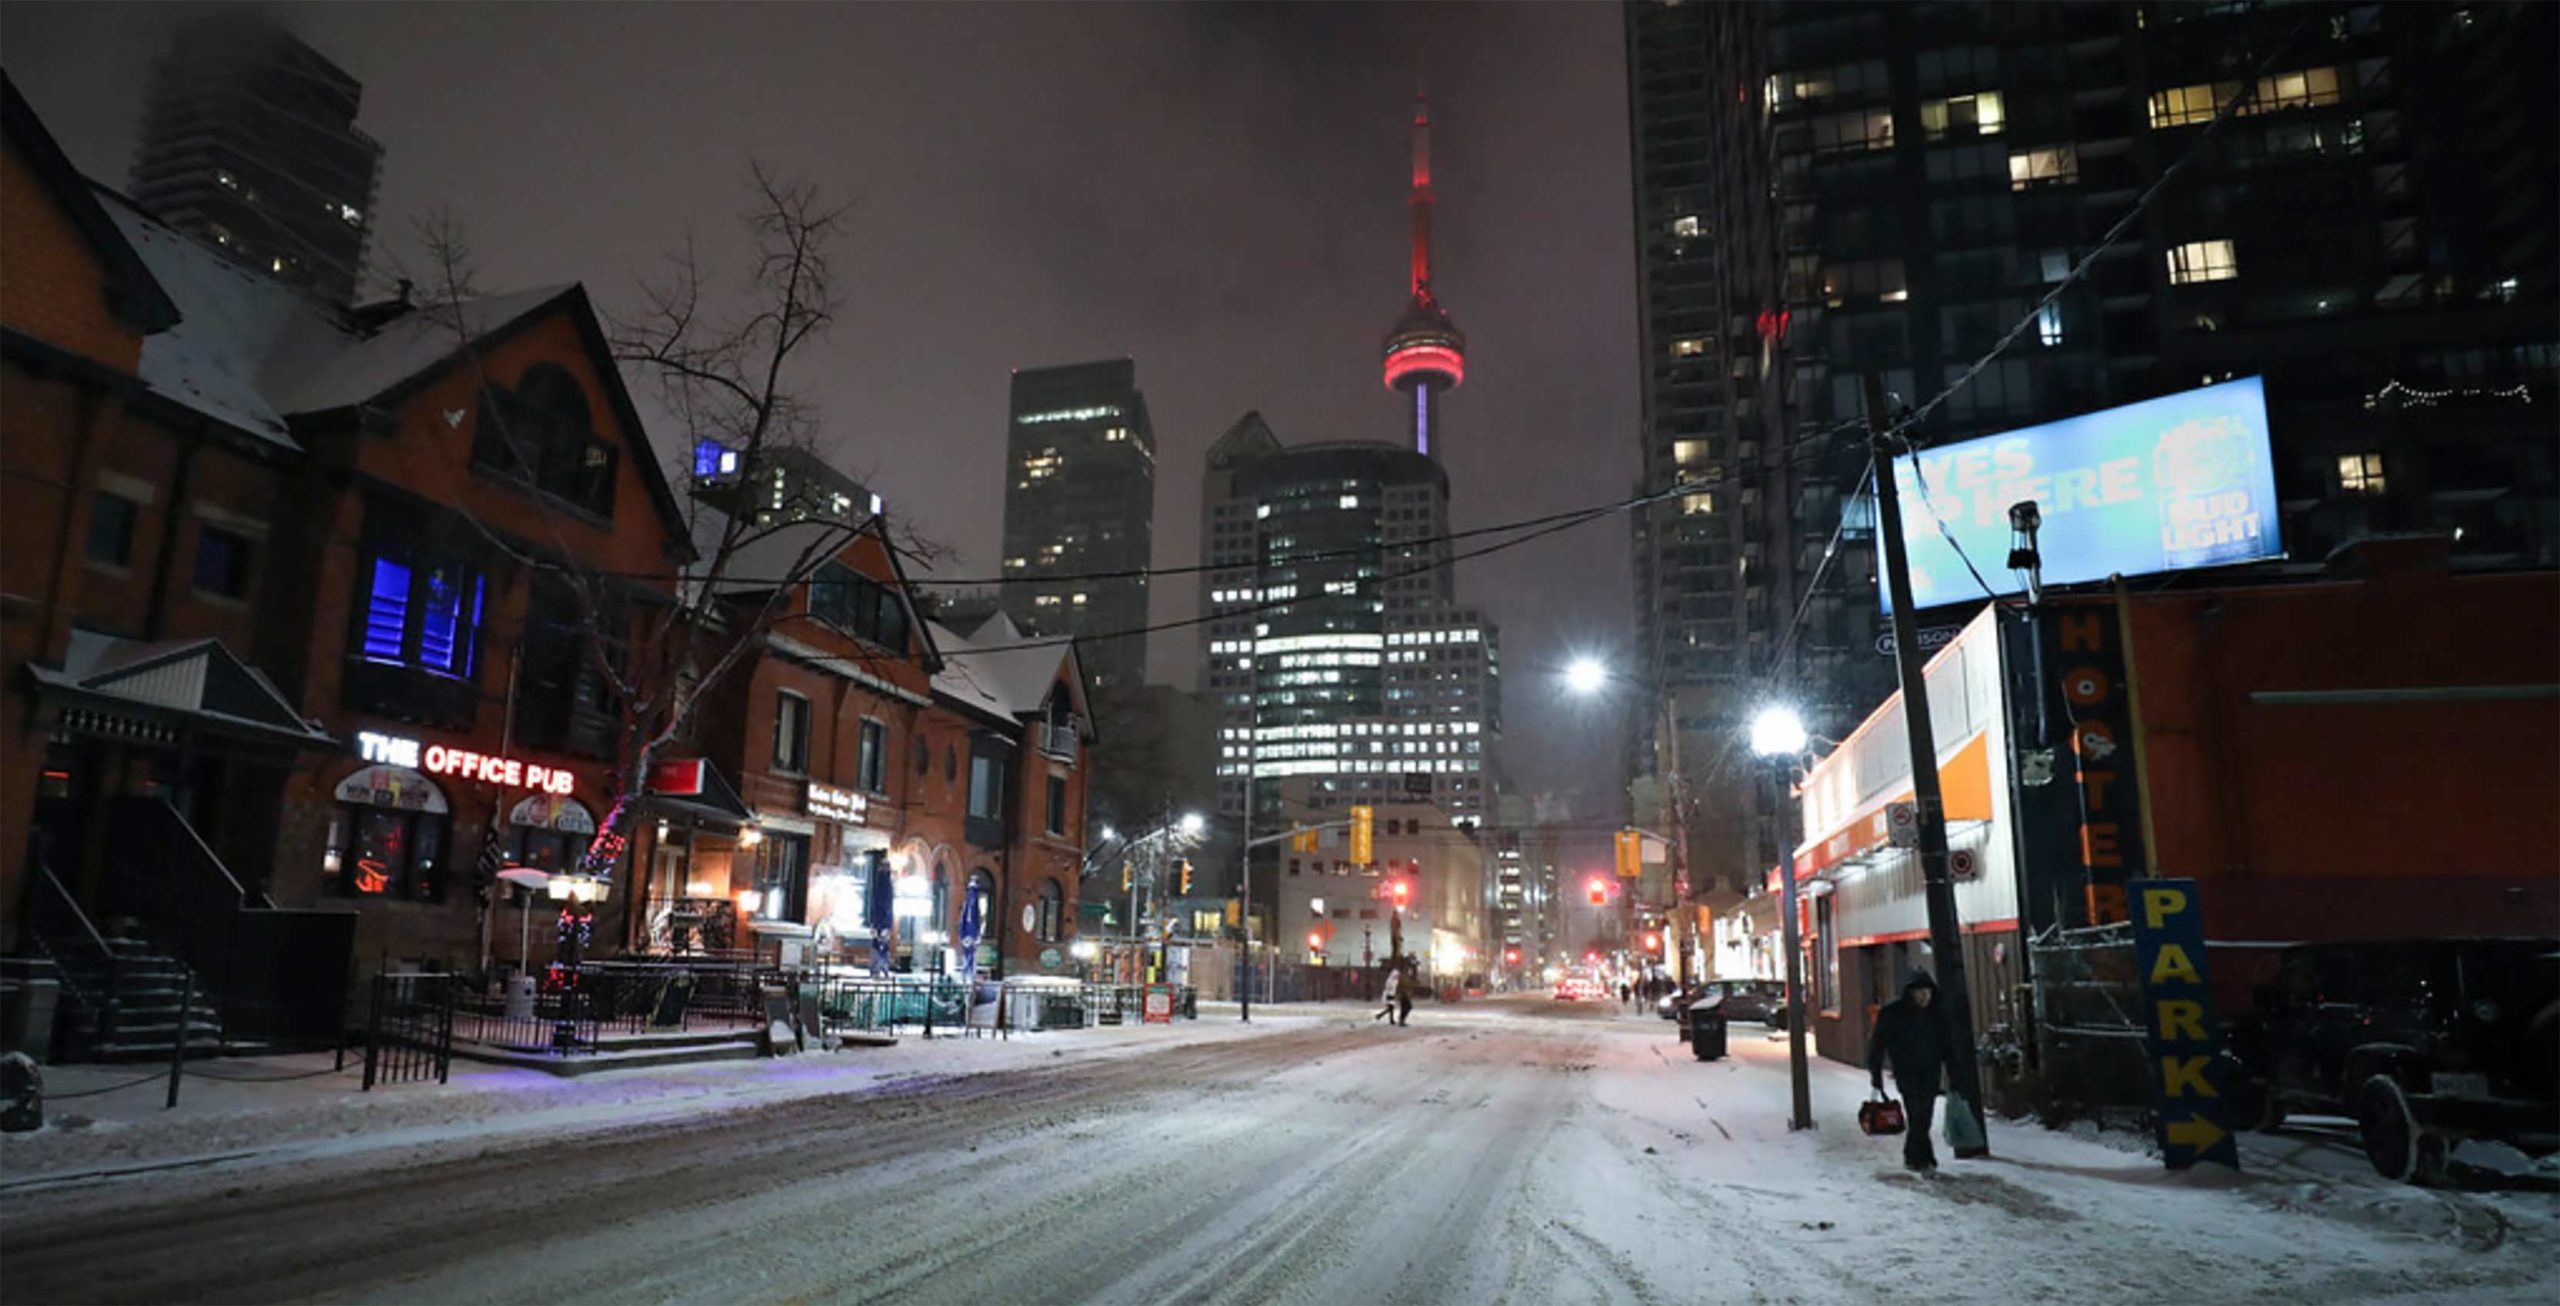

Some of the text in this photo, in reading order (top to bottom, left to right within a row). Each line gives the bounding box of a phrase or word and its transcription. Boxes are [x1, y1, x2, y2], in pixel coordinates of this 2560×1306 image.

[1975, 457, 2142, 527] HERE
[2161, 511, 2260, 551] LIGHT
[358, 731, 574, 794] THE OFFICE PUB
[2060, 612, 2134, 982] HOOTER
[2142, 888, 2220, 1098] PARK
